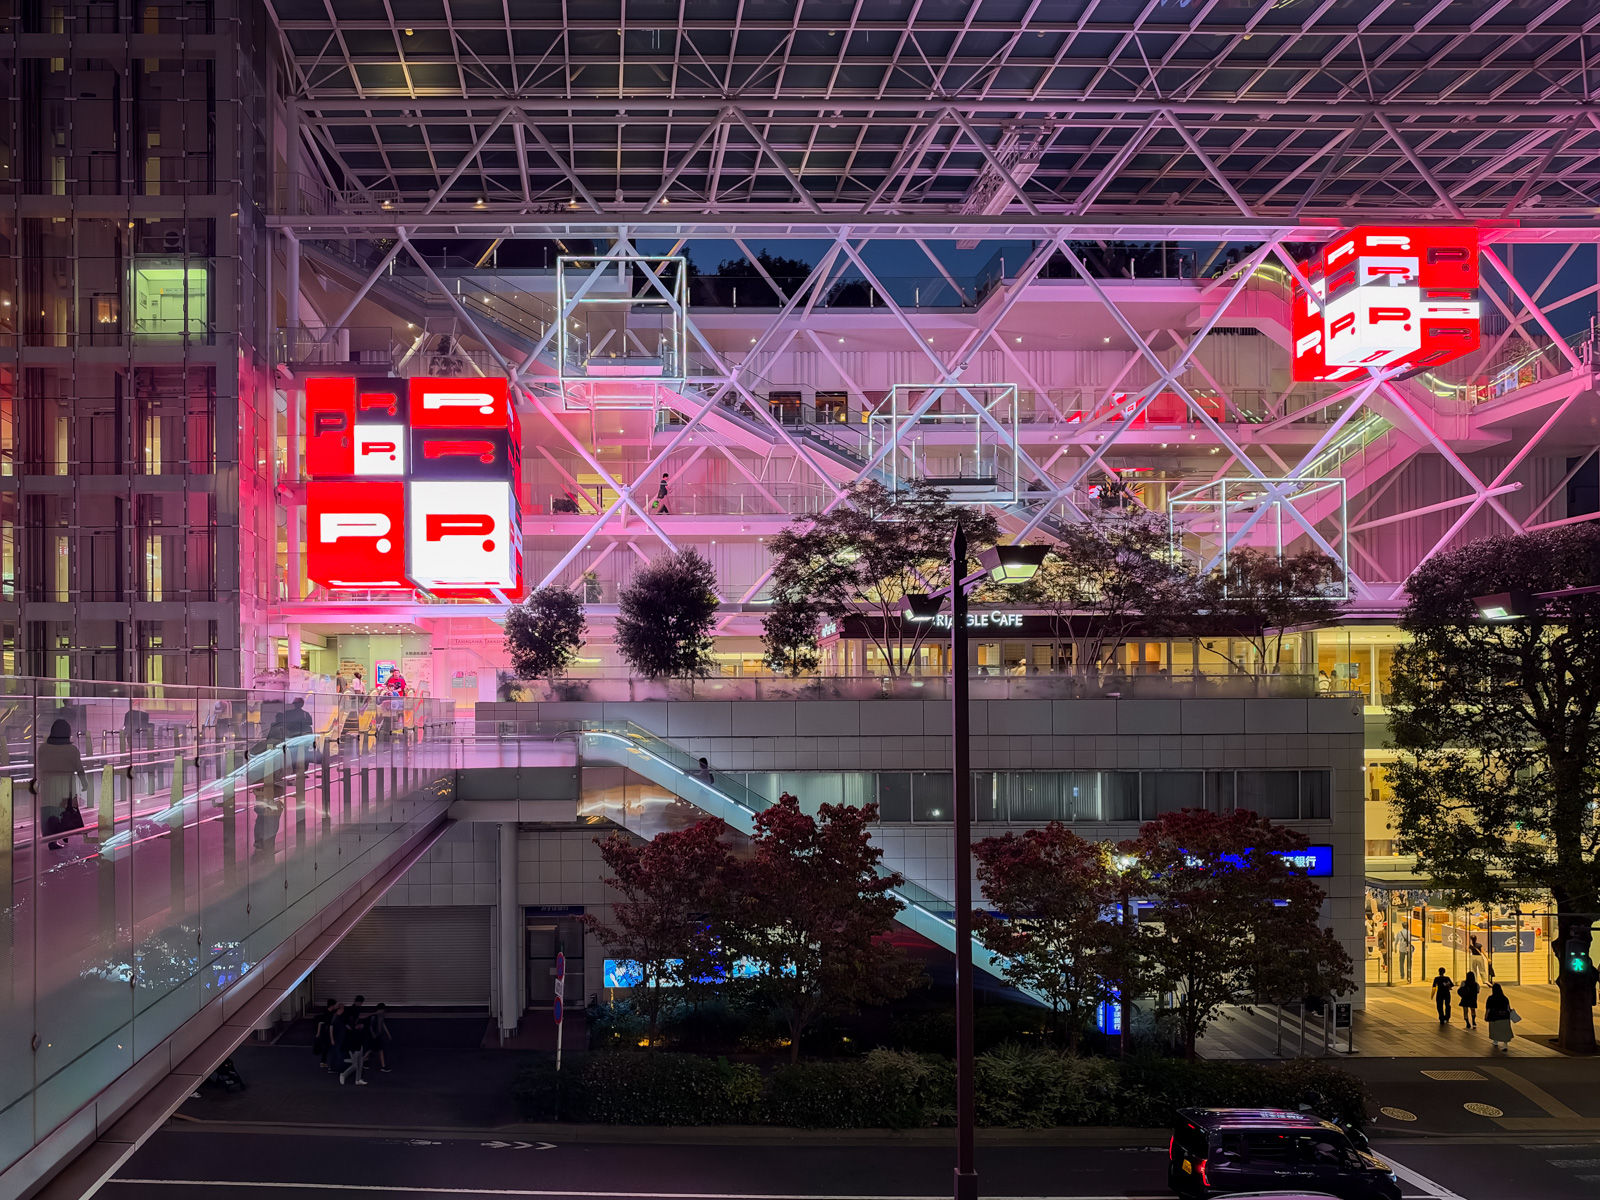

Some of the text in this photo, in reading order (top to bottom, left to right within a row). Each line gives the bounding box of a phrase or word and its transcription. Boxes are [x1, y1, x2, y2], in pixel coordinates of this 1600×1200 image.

[1369, 307, 1411, 331] P.
[320, 513, 391, 553] P.
[426, 514, 495, 552] P.
[991, 610, 1023, 626] CAFE
